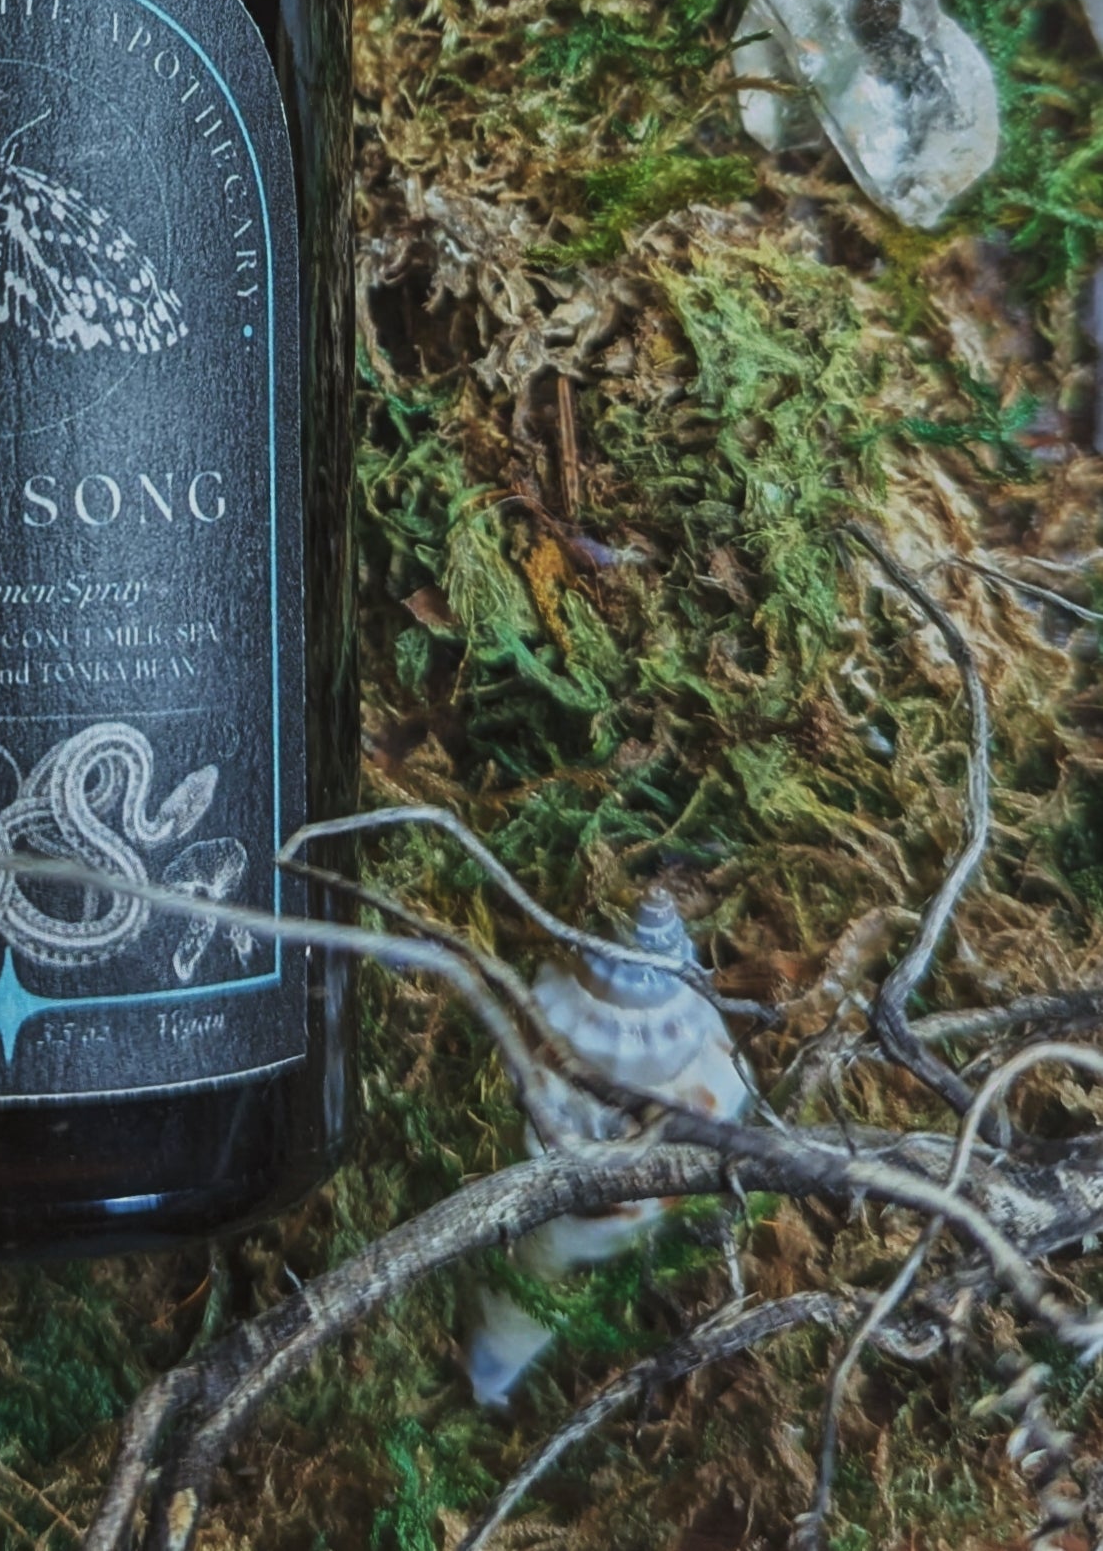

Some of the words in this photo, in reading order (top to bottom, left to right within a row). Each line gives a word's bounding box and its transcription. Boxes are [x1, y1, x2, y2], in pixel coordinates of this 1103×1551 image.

[103, 11, 259, 302] APOTHECARY
[23, 470, 226, 527] SONG
[61, 574, 147, 609] Spray
